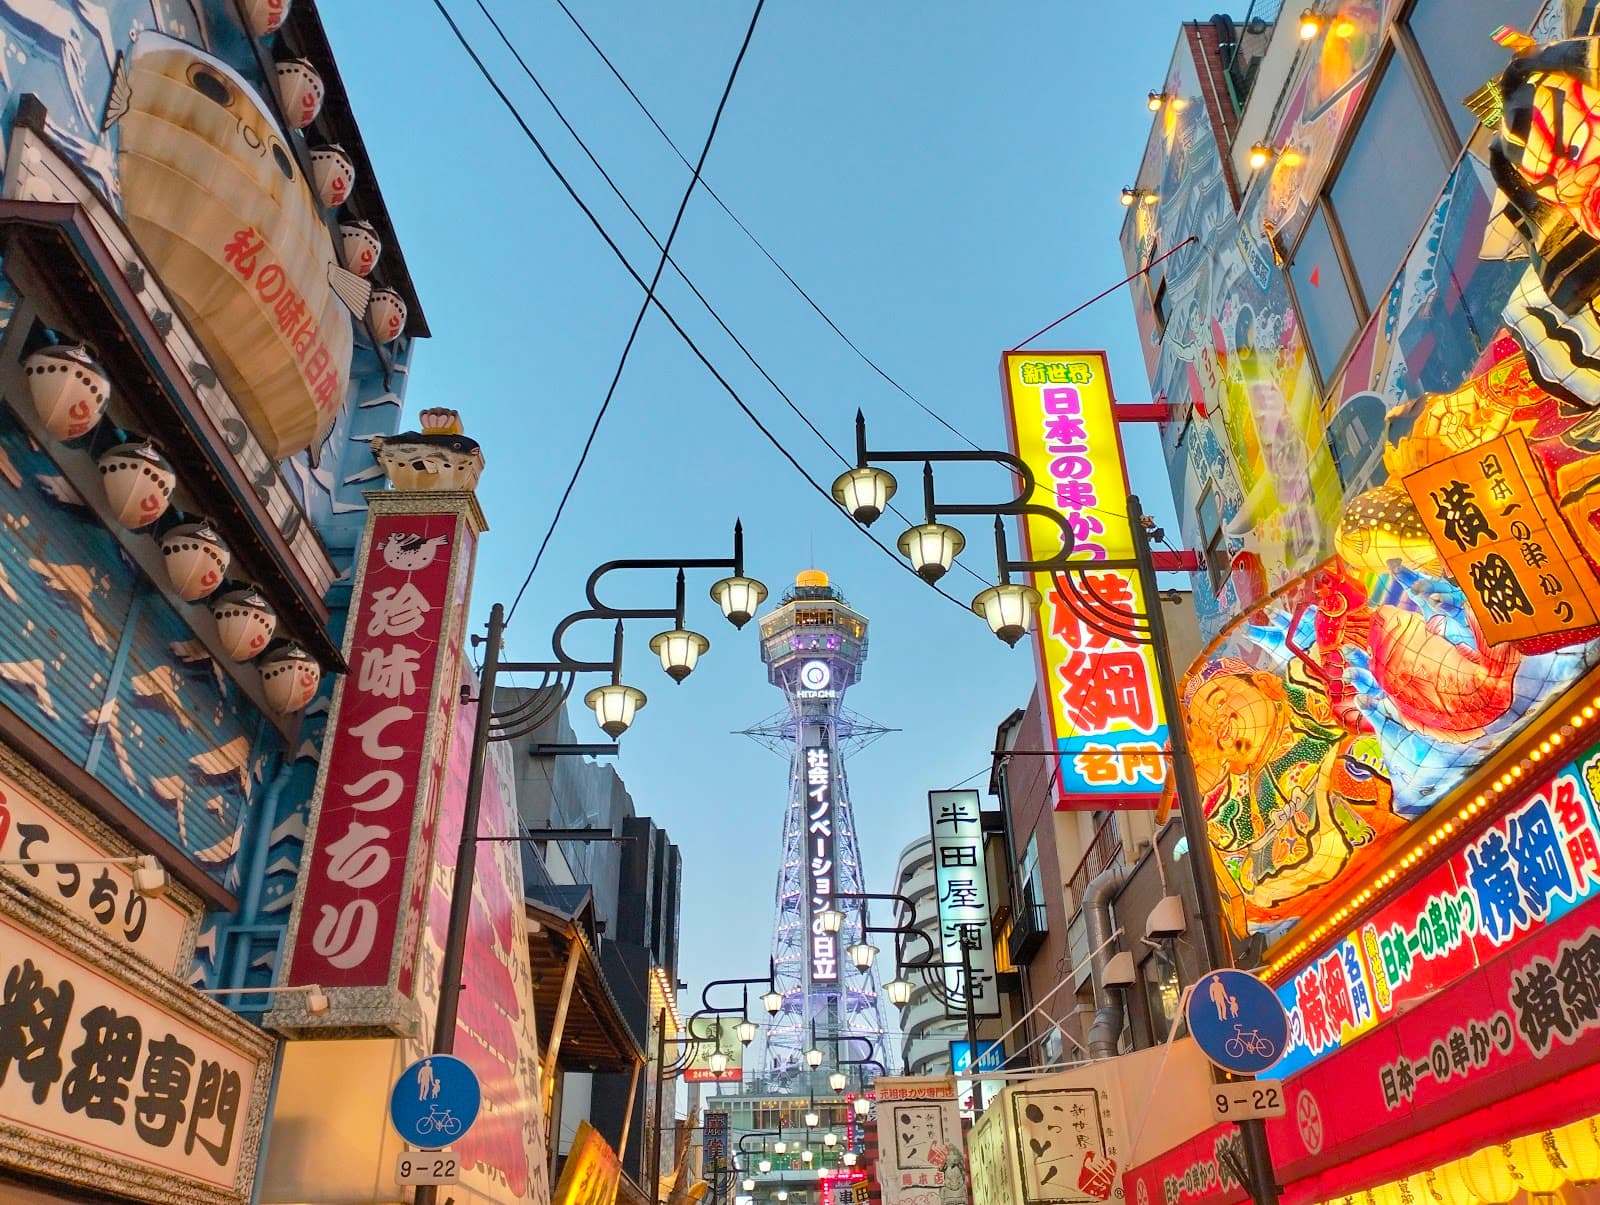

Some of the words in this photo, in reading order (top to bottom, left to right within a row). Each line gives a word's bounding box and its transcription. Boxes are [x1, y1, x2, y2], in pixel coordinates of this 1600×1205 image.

[1022, 363, 1093, 384] 新世界
[1043, 388, 1106, 564] 日本一の串かつ
[1479, 454, 1574, 623] 日本一の串かつ
[797, 690, 835, 698] HITACHI
[1049, 573, 1154, 732] 横綱
[1077, 745, 1164, 783] 名門
[17, 822, 147, 942] てっちり
[1467, 800, 1573, 941] 横綱
[1555, 782, 1600, 889] 名門
[1345, 945, 1371, 1024] 名門
[1381, 891, 1475, 986] 日本一の串かつ
[1297, 952, 1355, 1053] 横綱
[1513, 934, 1600, 1051] 横綱
[880, 1087, 954, 1099] 元祖串カツ専門店
[1216, 1089, 1280, 1113] 9-22
[1381, 1016, 1512, 1107] 日本一の串かつ
[400, 1160, 456, 1178] 9-22
